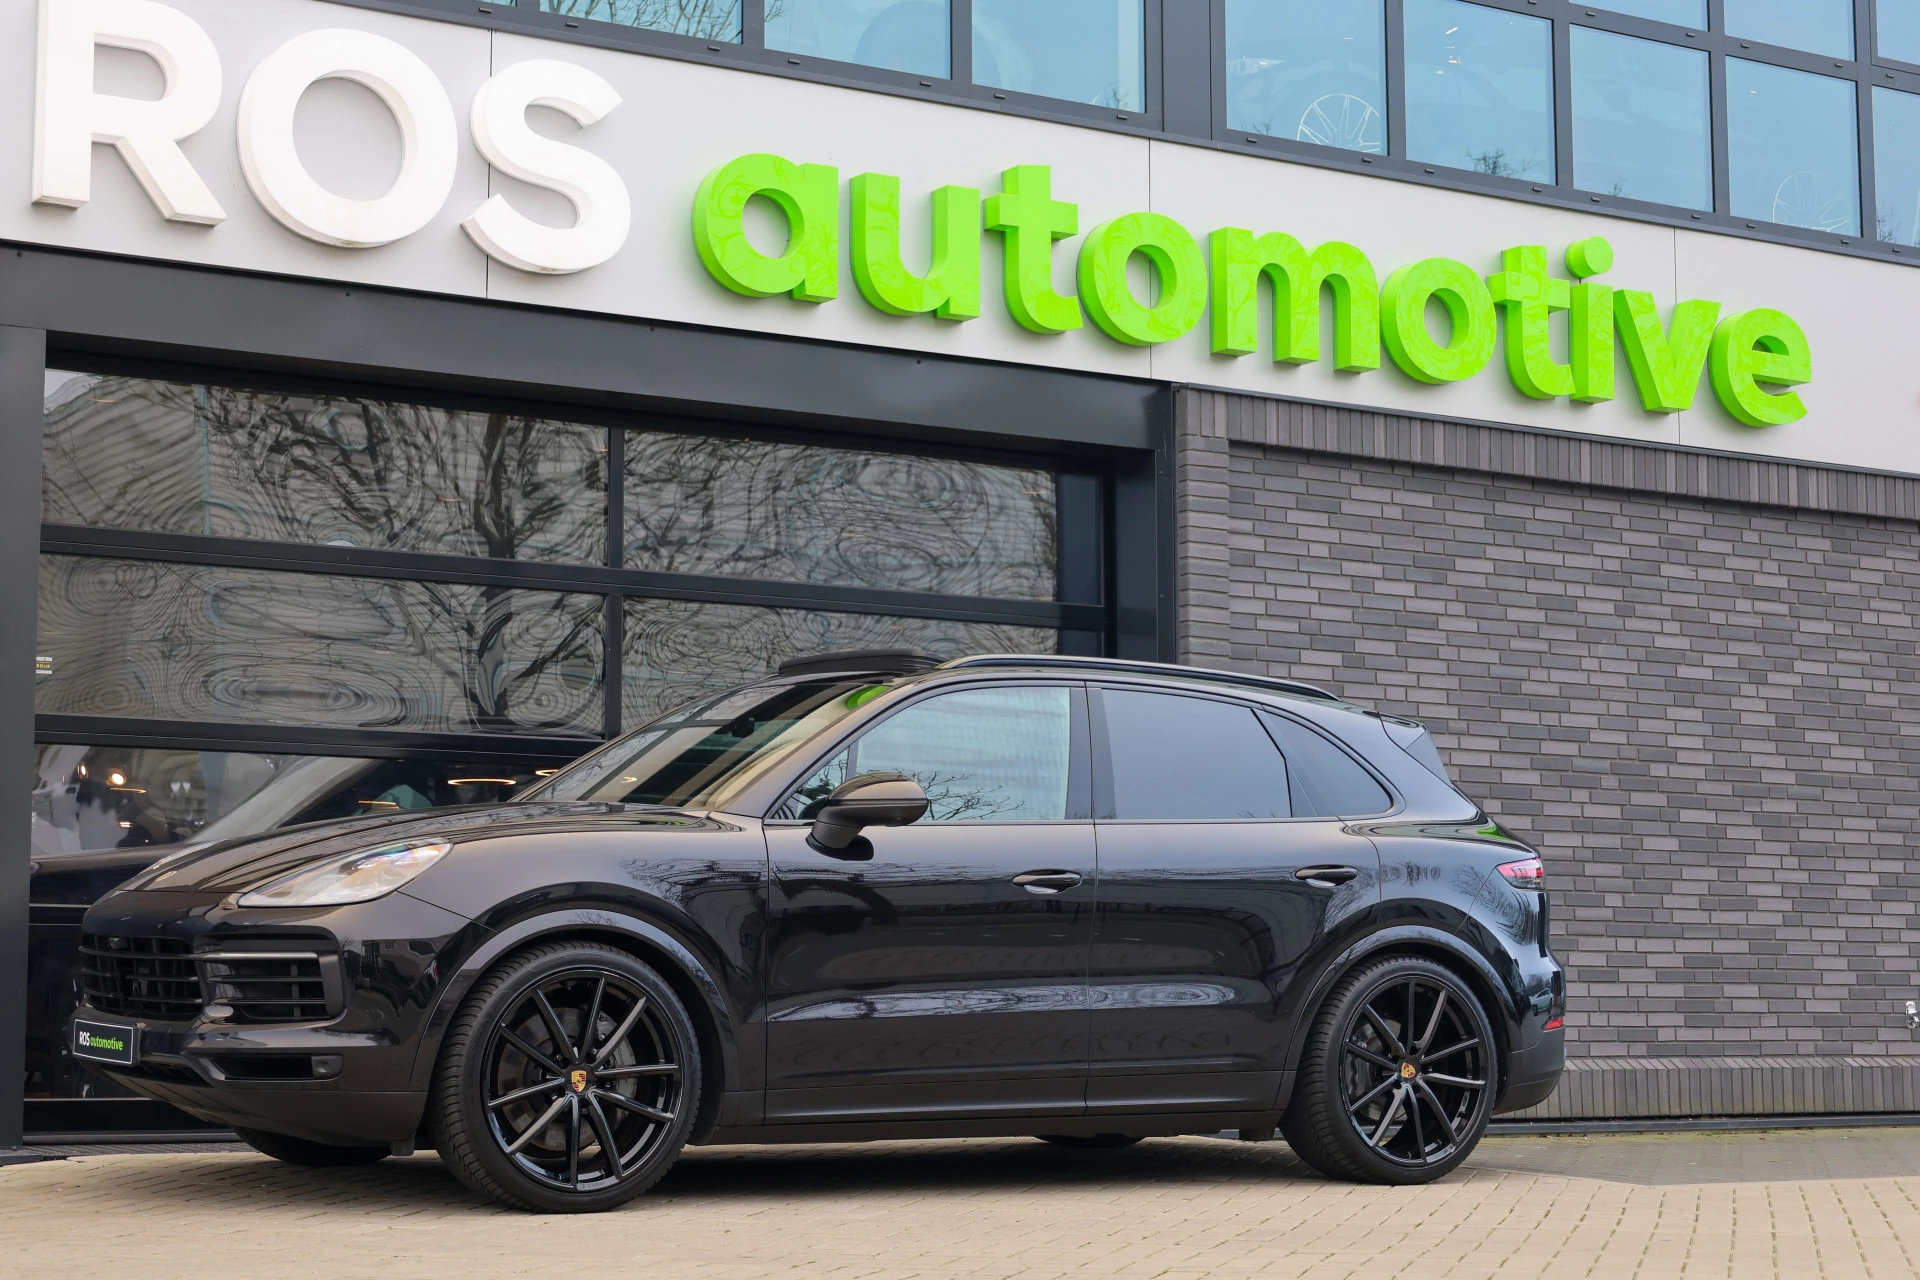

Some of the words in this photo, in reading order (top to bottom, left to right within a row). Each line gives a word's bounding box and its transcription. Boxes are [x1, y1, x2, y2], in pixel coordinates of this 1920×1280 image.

[31, 0, 631, 275] ROS
[690, 153, 1812, 428] automotive
[79, 1031, 91, 1047] ROS
[90, 1036, 124, 1051] automotive
